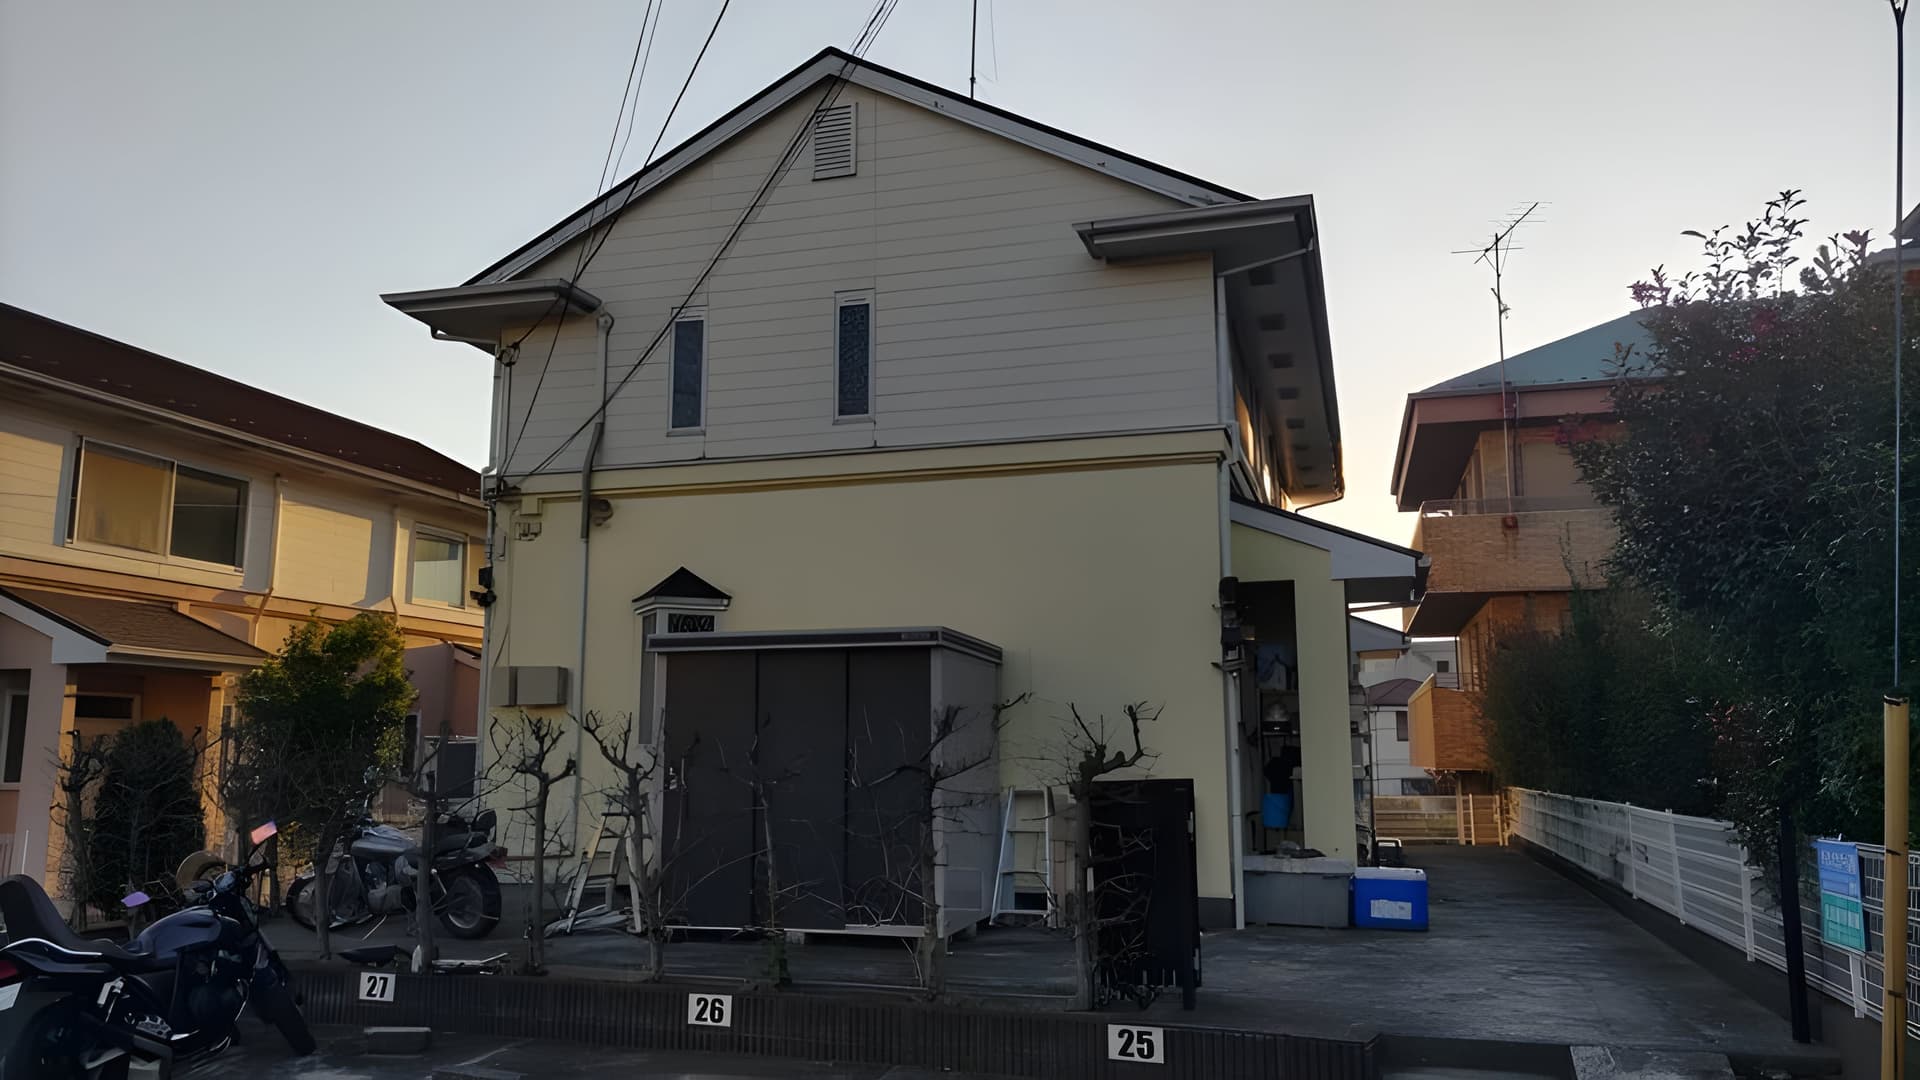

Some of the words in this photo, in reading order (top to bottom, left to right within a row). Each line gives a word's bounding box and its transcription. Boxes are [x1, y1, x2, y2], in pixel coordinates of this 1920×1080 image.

[366, 975, 388, 998] 27
[695, 997, 724, 1023] 26
[1118, 1028, 1155, 1060] 25
